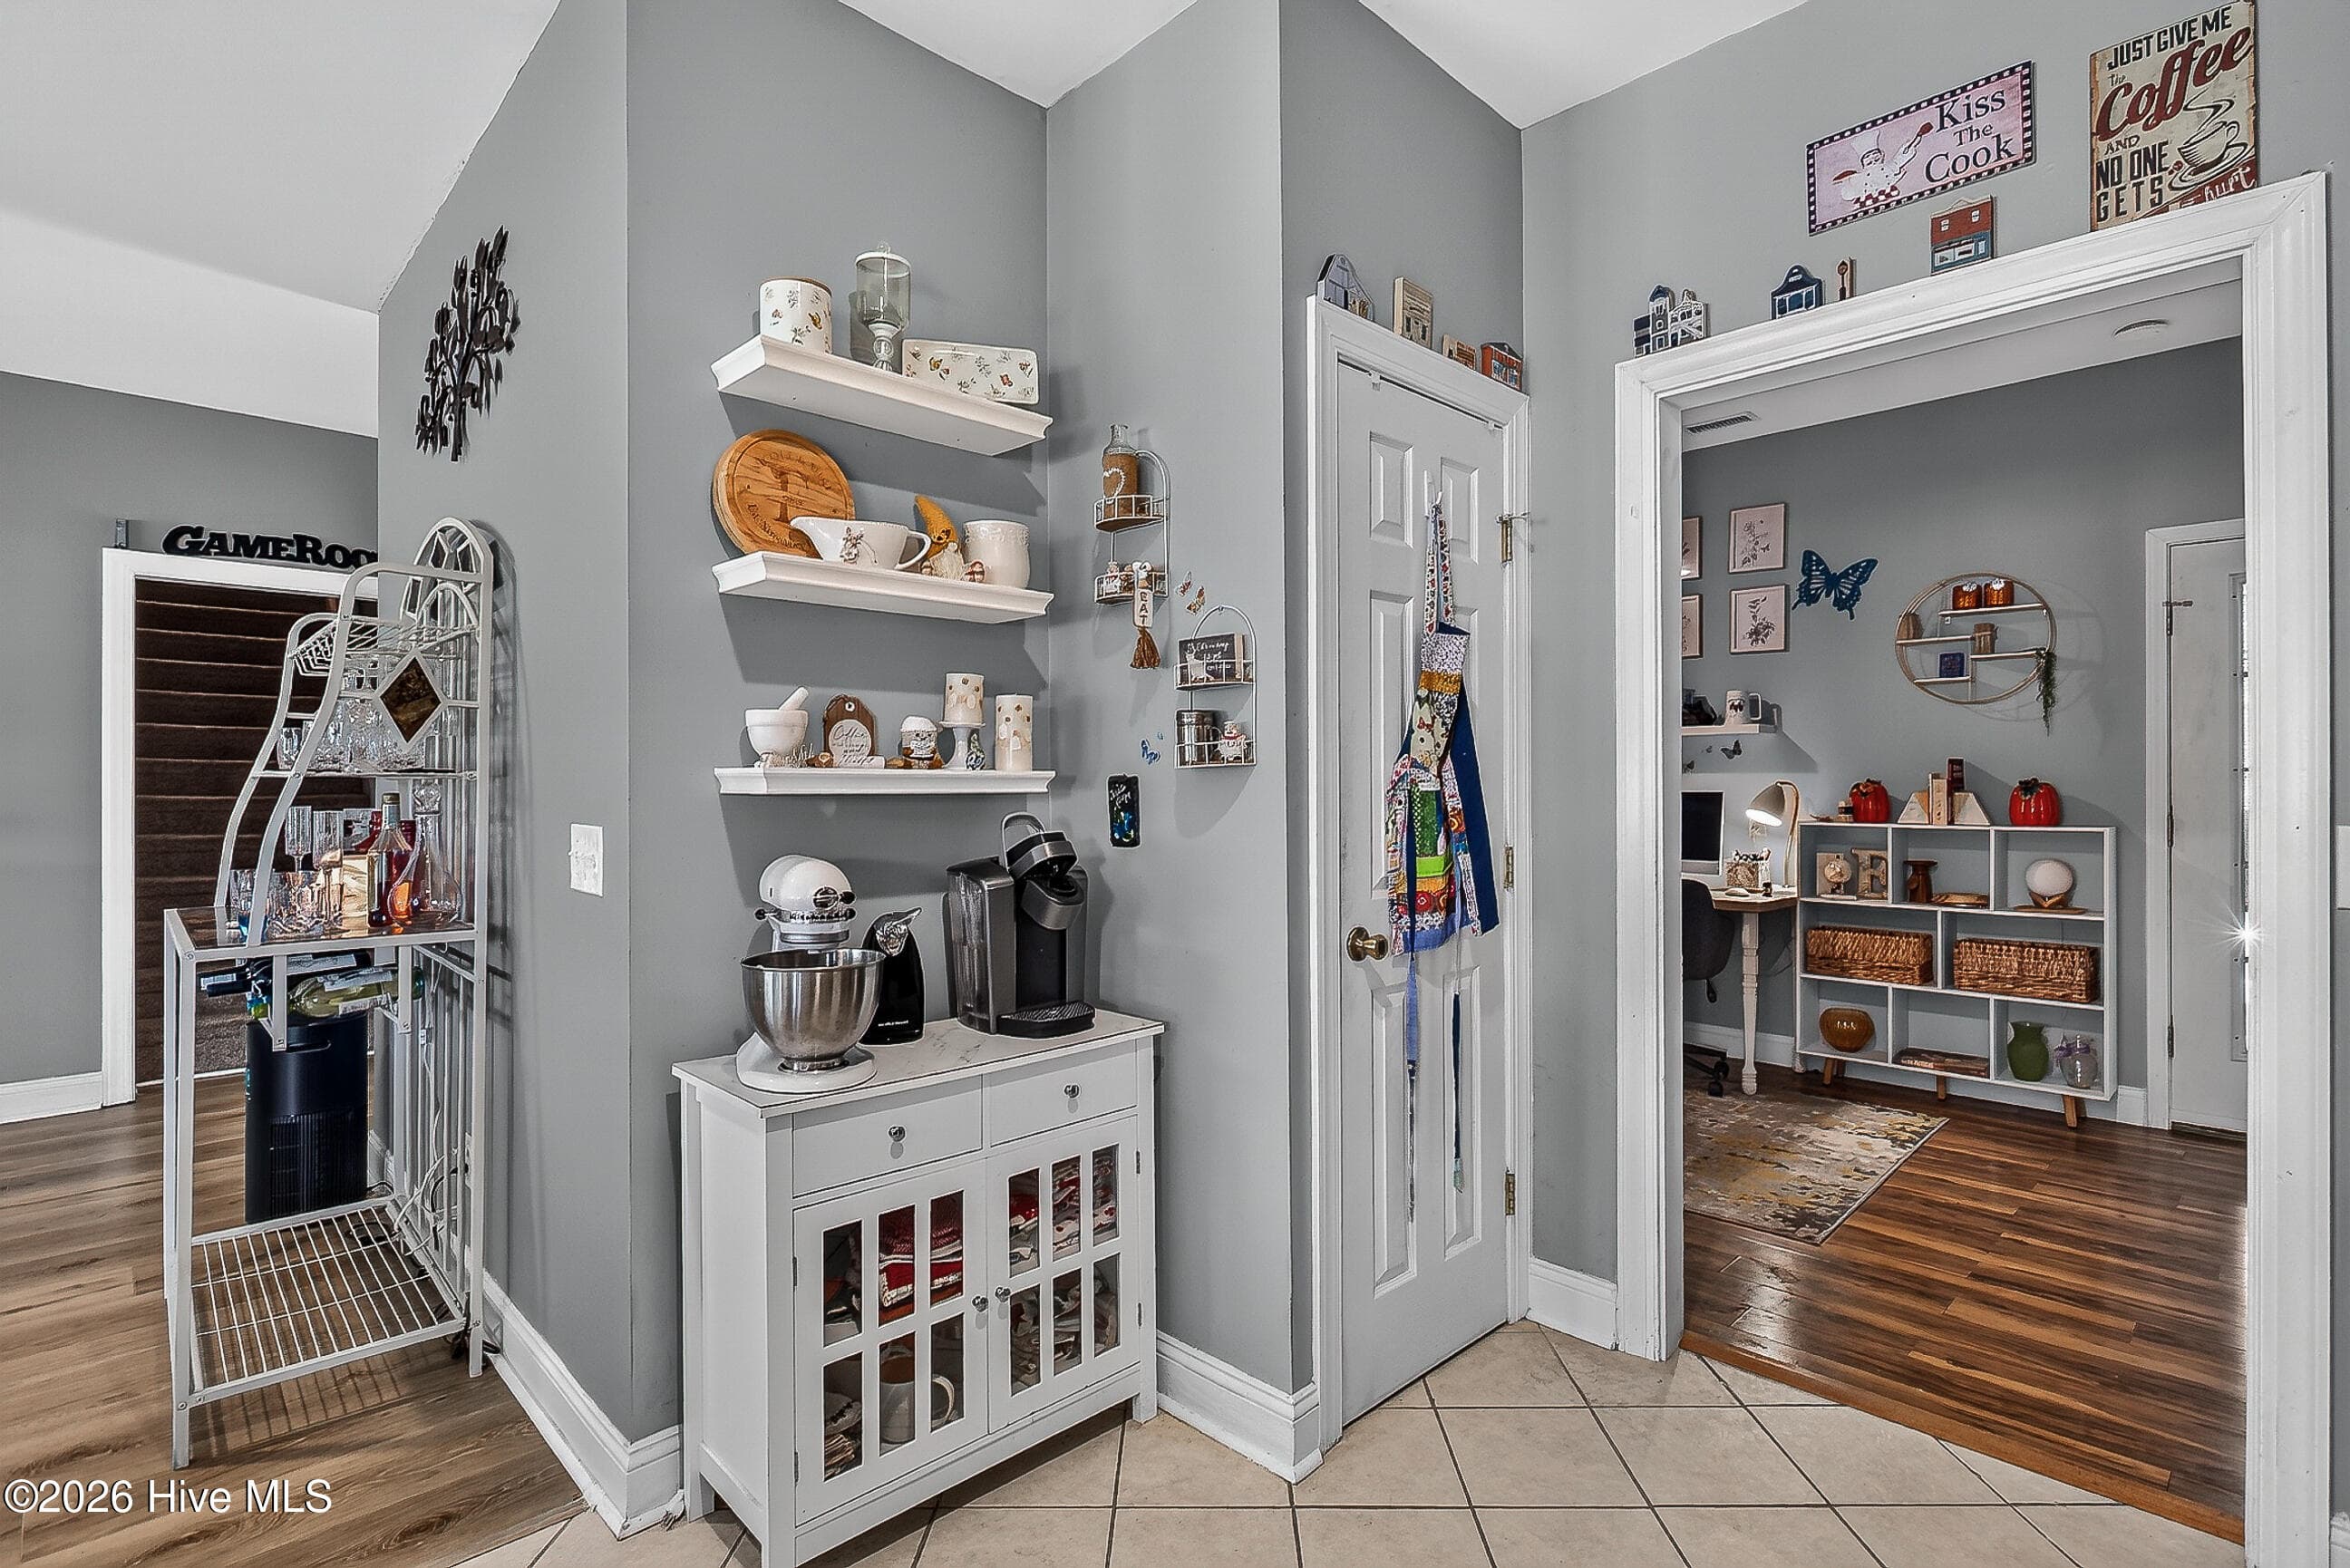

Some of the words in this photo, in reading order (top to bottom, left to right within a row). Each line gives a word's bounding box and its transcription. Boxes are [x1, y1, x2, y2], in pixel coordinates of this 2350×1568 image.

[2108, 35, 2153, 71] JUST
[2157, 18, 2199, 53] GIVE
[2202, 6, 2232, 37] ME
[2095, 26, 2254, 142] Coffee
[1935, 90, 2005, 133] Kiss
[1953, 123, 1994, 147] The
[1925, 133, 2017, 183] Cook
[2096, 155, 2123, 192] NO
[2131, 140, 2170, 182] ONE
[2104, 135, 2141, 156] AND
[2096, 176, 2164, 223] GETS
[1139, 591, 1149, 625] EAT
